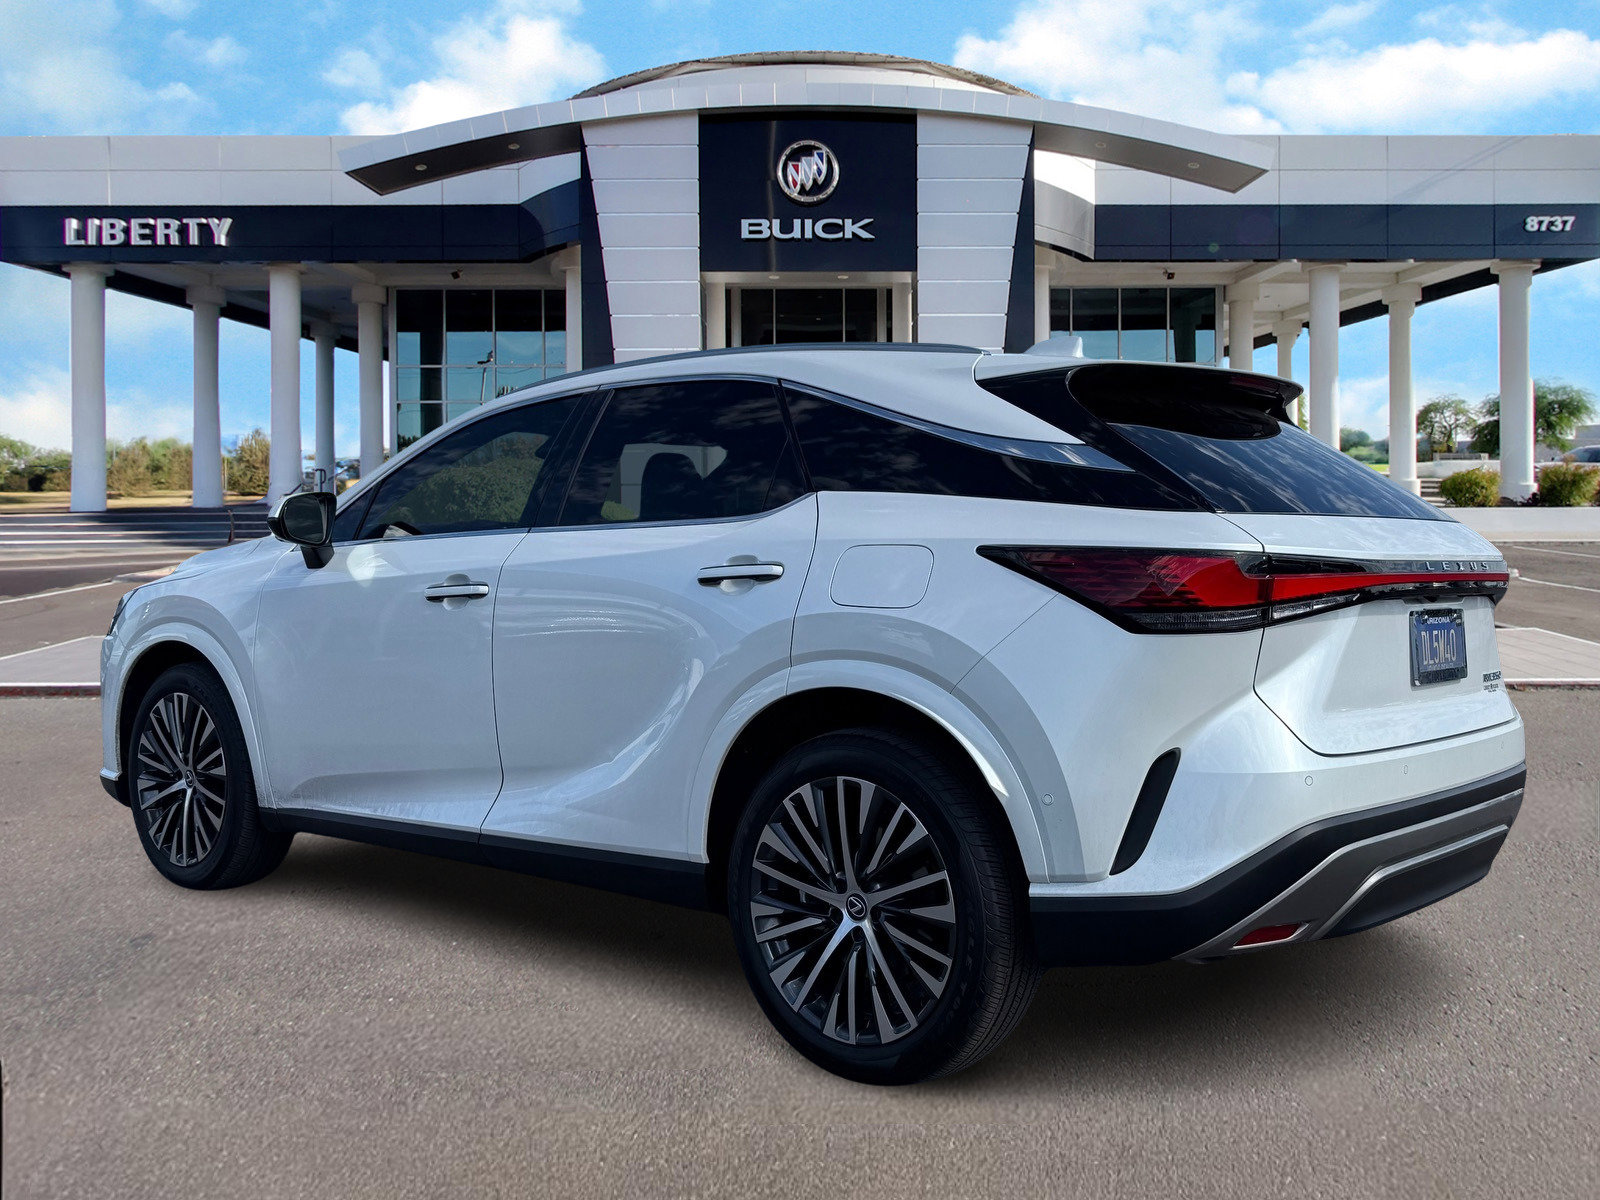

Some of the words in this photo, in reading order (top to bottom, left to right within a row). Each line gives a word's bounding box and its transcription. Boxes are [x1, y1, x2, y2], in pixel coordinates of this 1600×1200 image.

[63, 217, 234, 247] LIBERTY
[740, 218, 876, 240] BUICK
[1524, 215, 1577, 232] 8737
[1425, 561, 1489, 571] LEXUS
